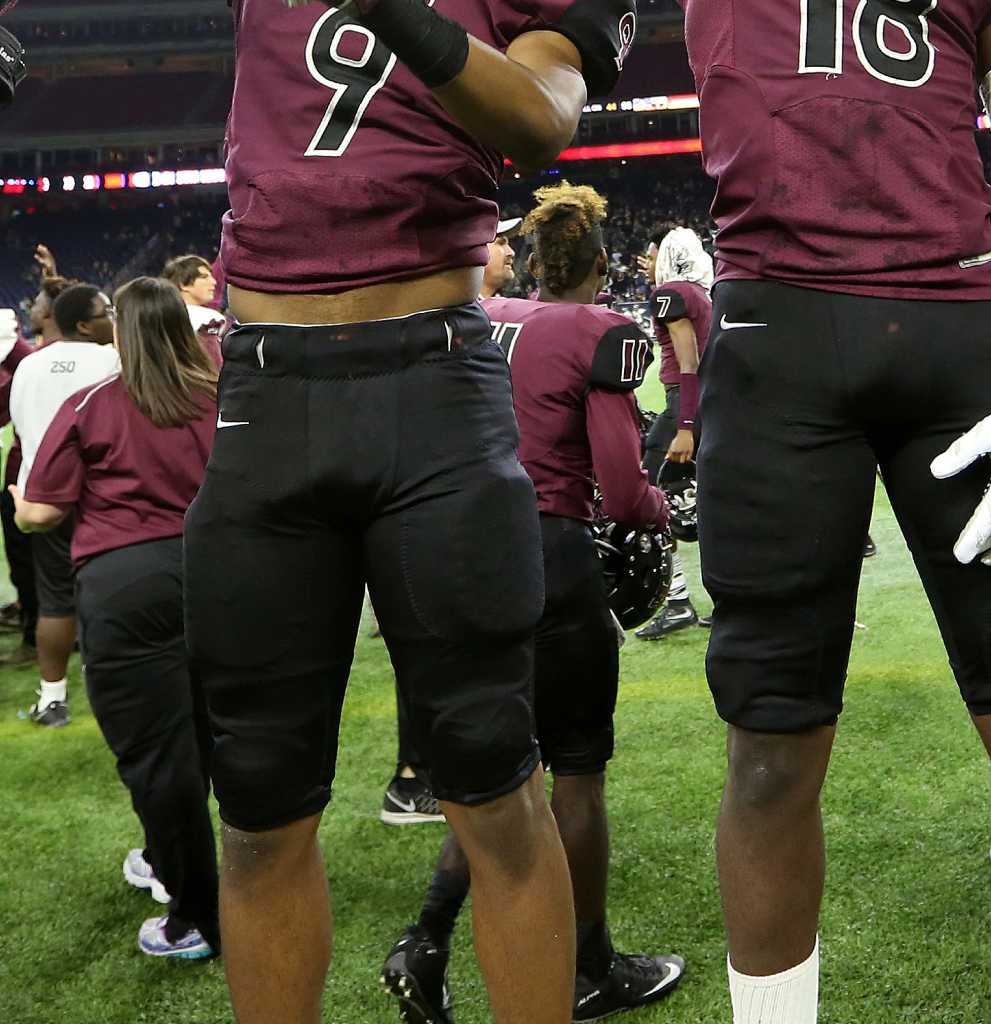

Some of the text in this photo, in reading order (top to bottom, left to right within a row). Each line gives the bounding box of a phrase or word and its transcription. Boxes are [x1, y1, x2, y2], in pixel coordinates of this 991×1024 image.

[614, 11, 636, 72] 9
[304, 6, 398, 157] 9
[656, 296, 671, 318] 7
[620, 338, 649, 383] 11
